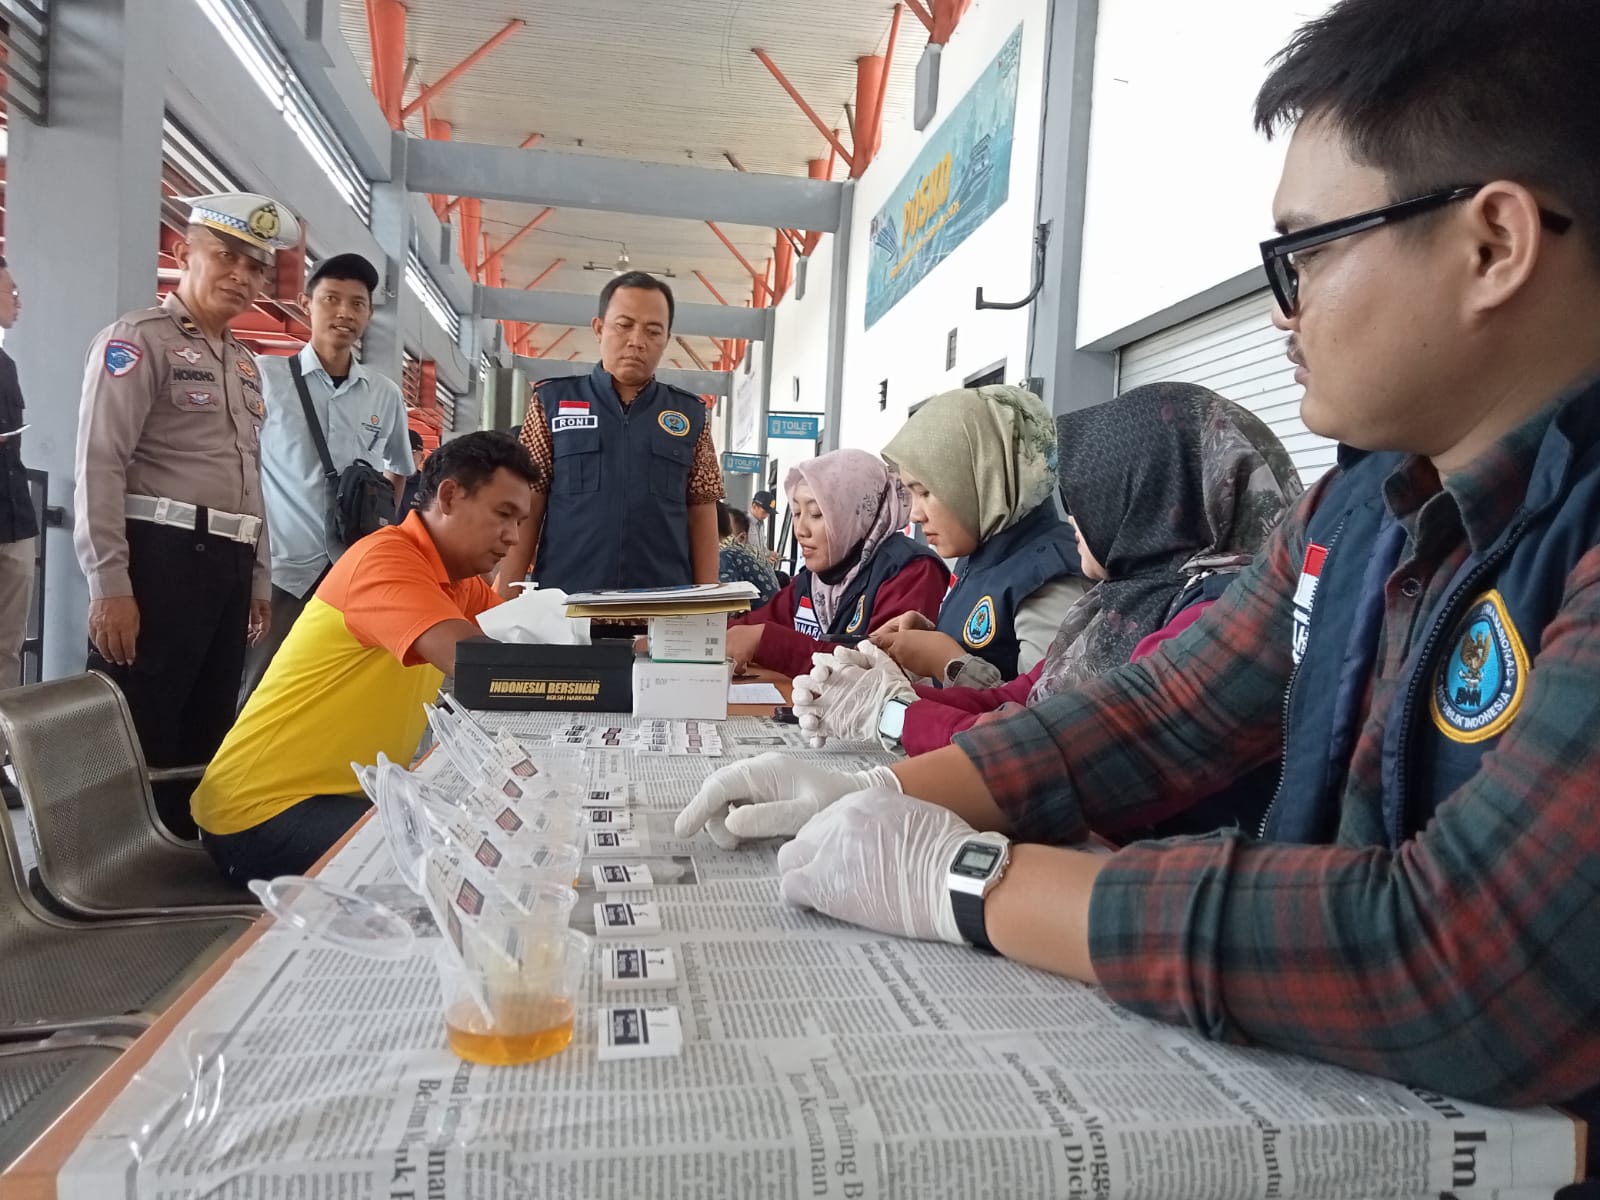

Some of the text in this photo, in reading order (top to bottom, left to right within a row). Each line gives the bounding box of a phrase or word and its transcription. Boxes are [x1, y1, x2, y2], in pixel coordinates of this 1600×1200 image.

[559, 418, 589, 428] RONI
[782, 421, 814, 431] TOILET
[489, 681, 600, 695] INDONESIA BERSINAR
[1464, 692, 1511, 729] INDONESIA
